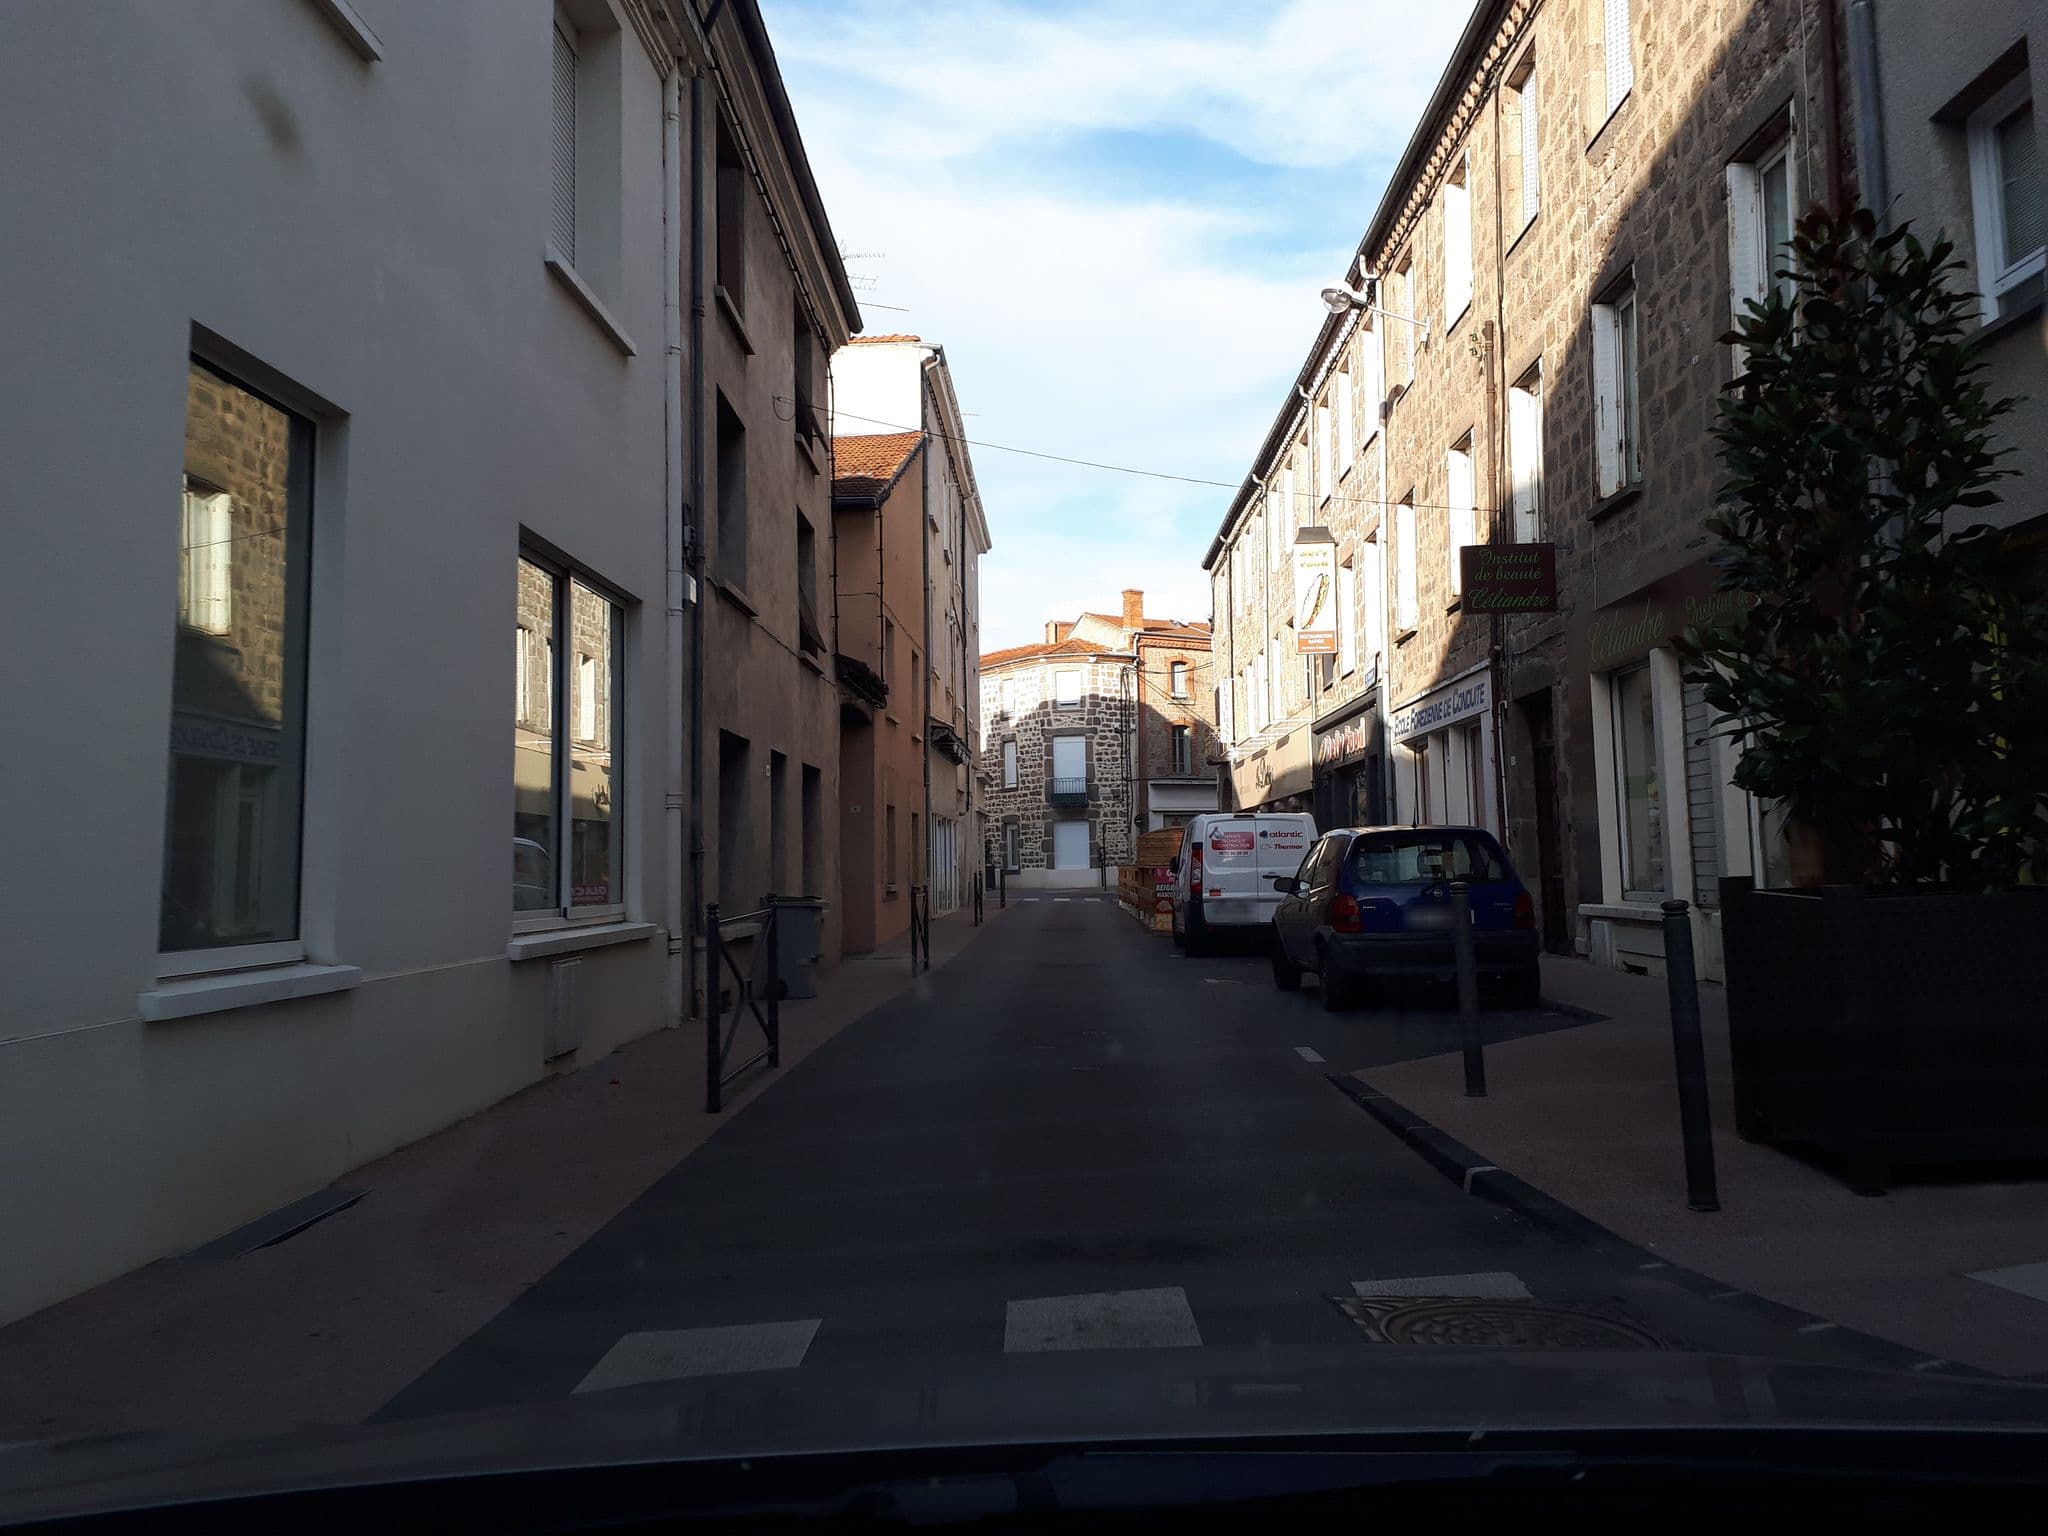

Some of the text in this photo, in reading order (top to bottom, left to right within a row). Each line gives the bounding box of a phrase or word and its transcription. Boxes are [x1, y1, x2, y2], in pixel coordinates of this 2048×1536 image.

[1479, 548, 1540, 566] Institut
[1473, 566, 1543, 581] de beauté
[1394, 715, 1410, 738] ECOLE
[1443, 697, 1452, 718] DE
[1452, 682, 1485, 714] CONDUITE
[1269, 830, 1303, 838] atlantic
